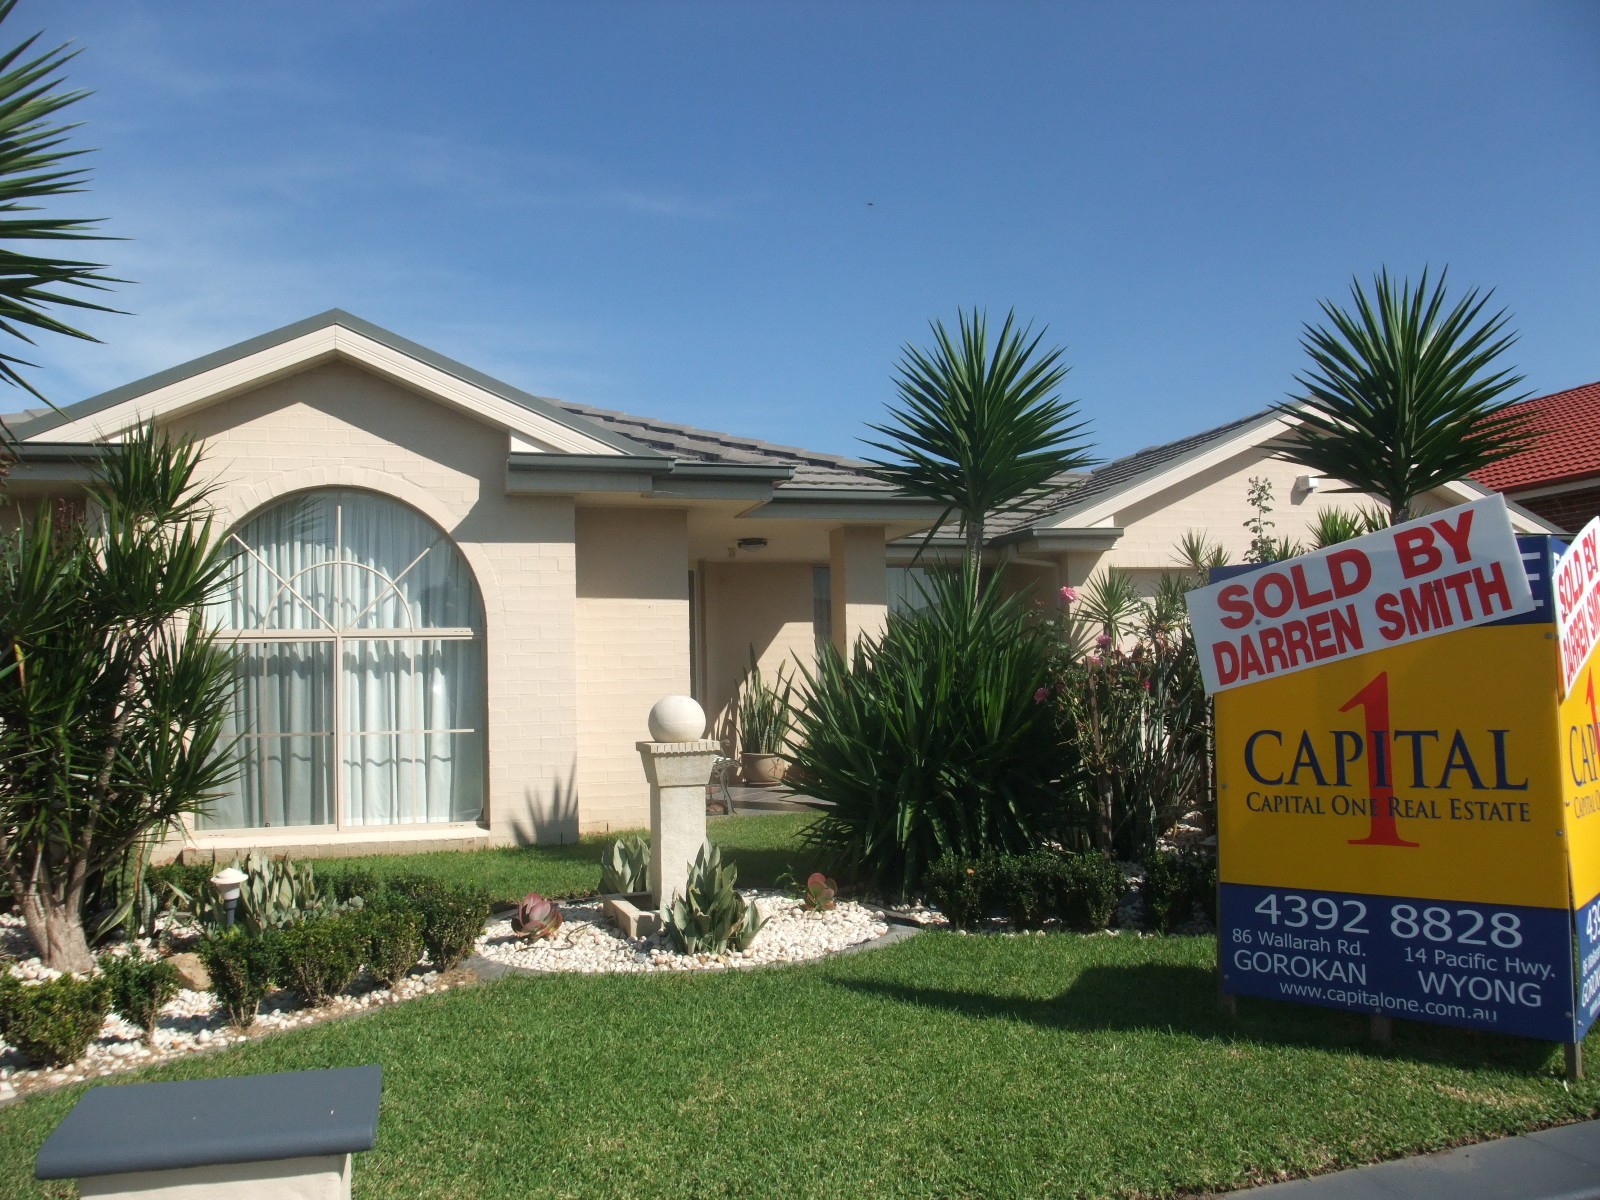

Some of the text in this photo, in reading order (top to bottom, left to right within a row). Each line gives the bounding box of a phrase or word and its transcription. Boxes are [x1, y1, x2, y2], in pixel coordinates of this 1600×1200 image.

[1217, 548, 1372, 629] SOLD
[1393, 509, 1474, 580] BY
[1558, 528, 1599, 624] SOLD BY
[1212, 604, 1365, 686] DARREN
[1375, 561, 1513, 641] SMITH
[1244, 729, 1529, 791] CAPITAL
[1338, 671, 1420, 847] 1
[1246, 792, 1326, 815] CAPITAL
[1389, 797, 1441, 819] REAL
[1450, 798, 1531, 822] ESTATE
[1232, 928, 1366, 957] 86 Wallarah Rd.
[1255, 894, 1523, 949] 4392 8828
[1233, 949, 1367, 986] GOROKAN
[1404, 947, 1427, 963] 14
[1434, 950, 1496, 972] Pacific
[1505, 957, 1556, 980] Hwy.
[1279, 983, 1497, 1023] www.capitalone.com.au
[1417, 970, 1542, 1008] WYONG
